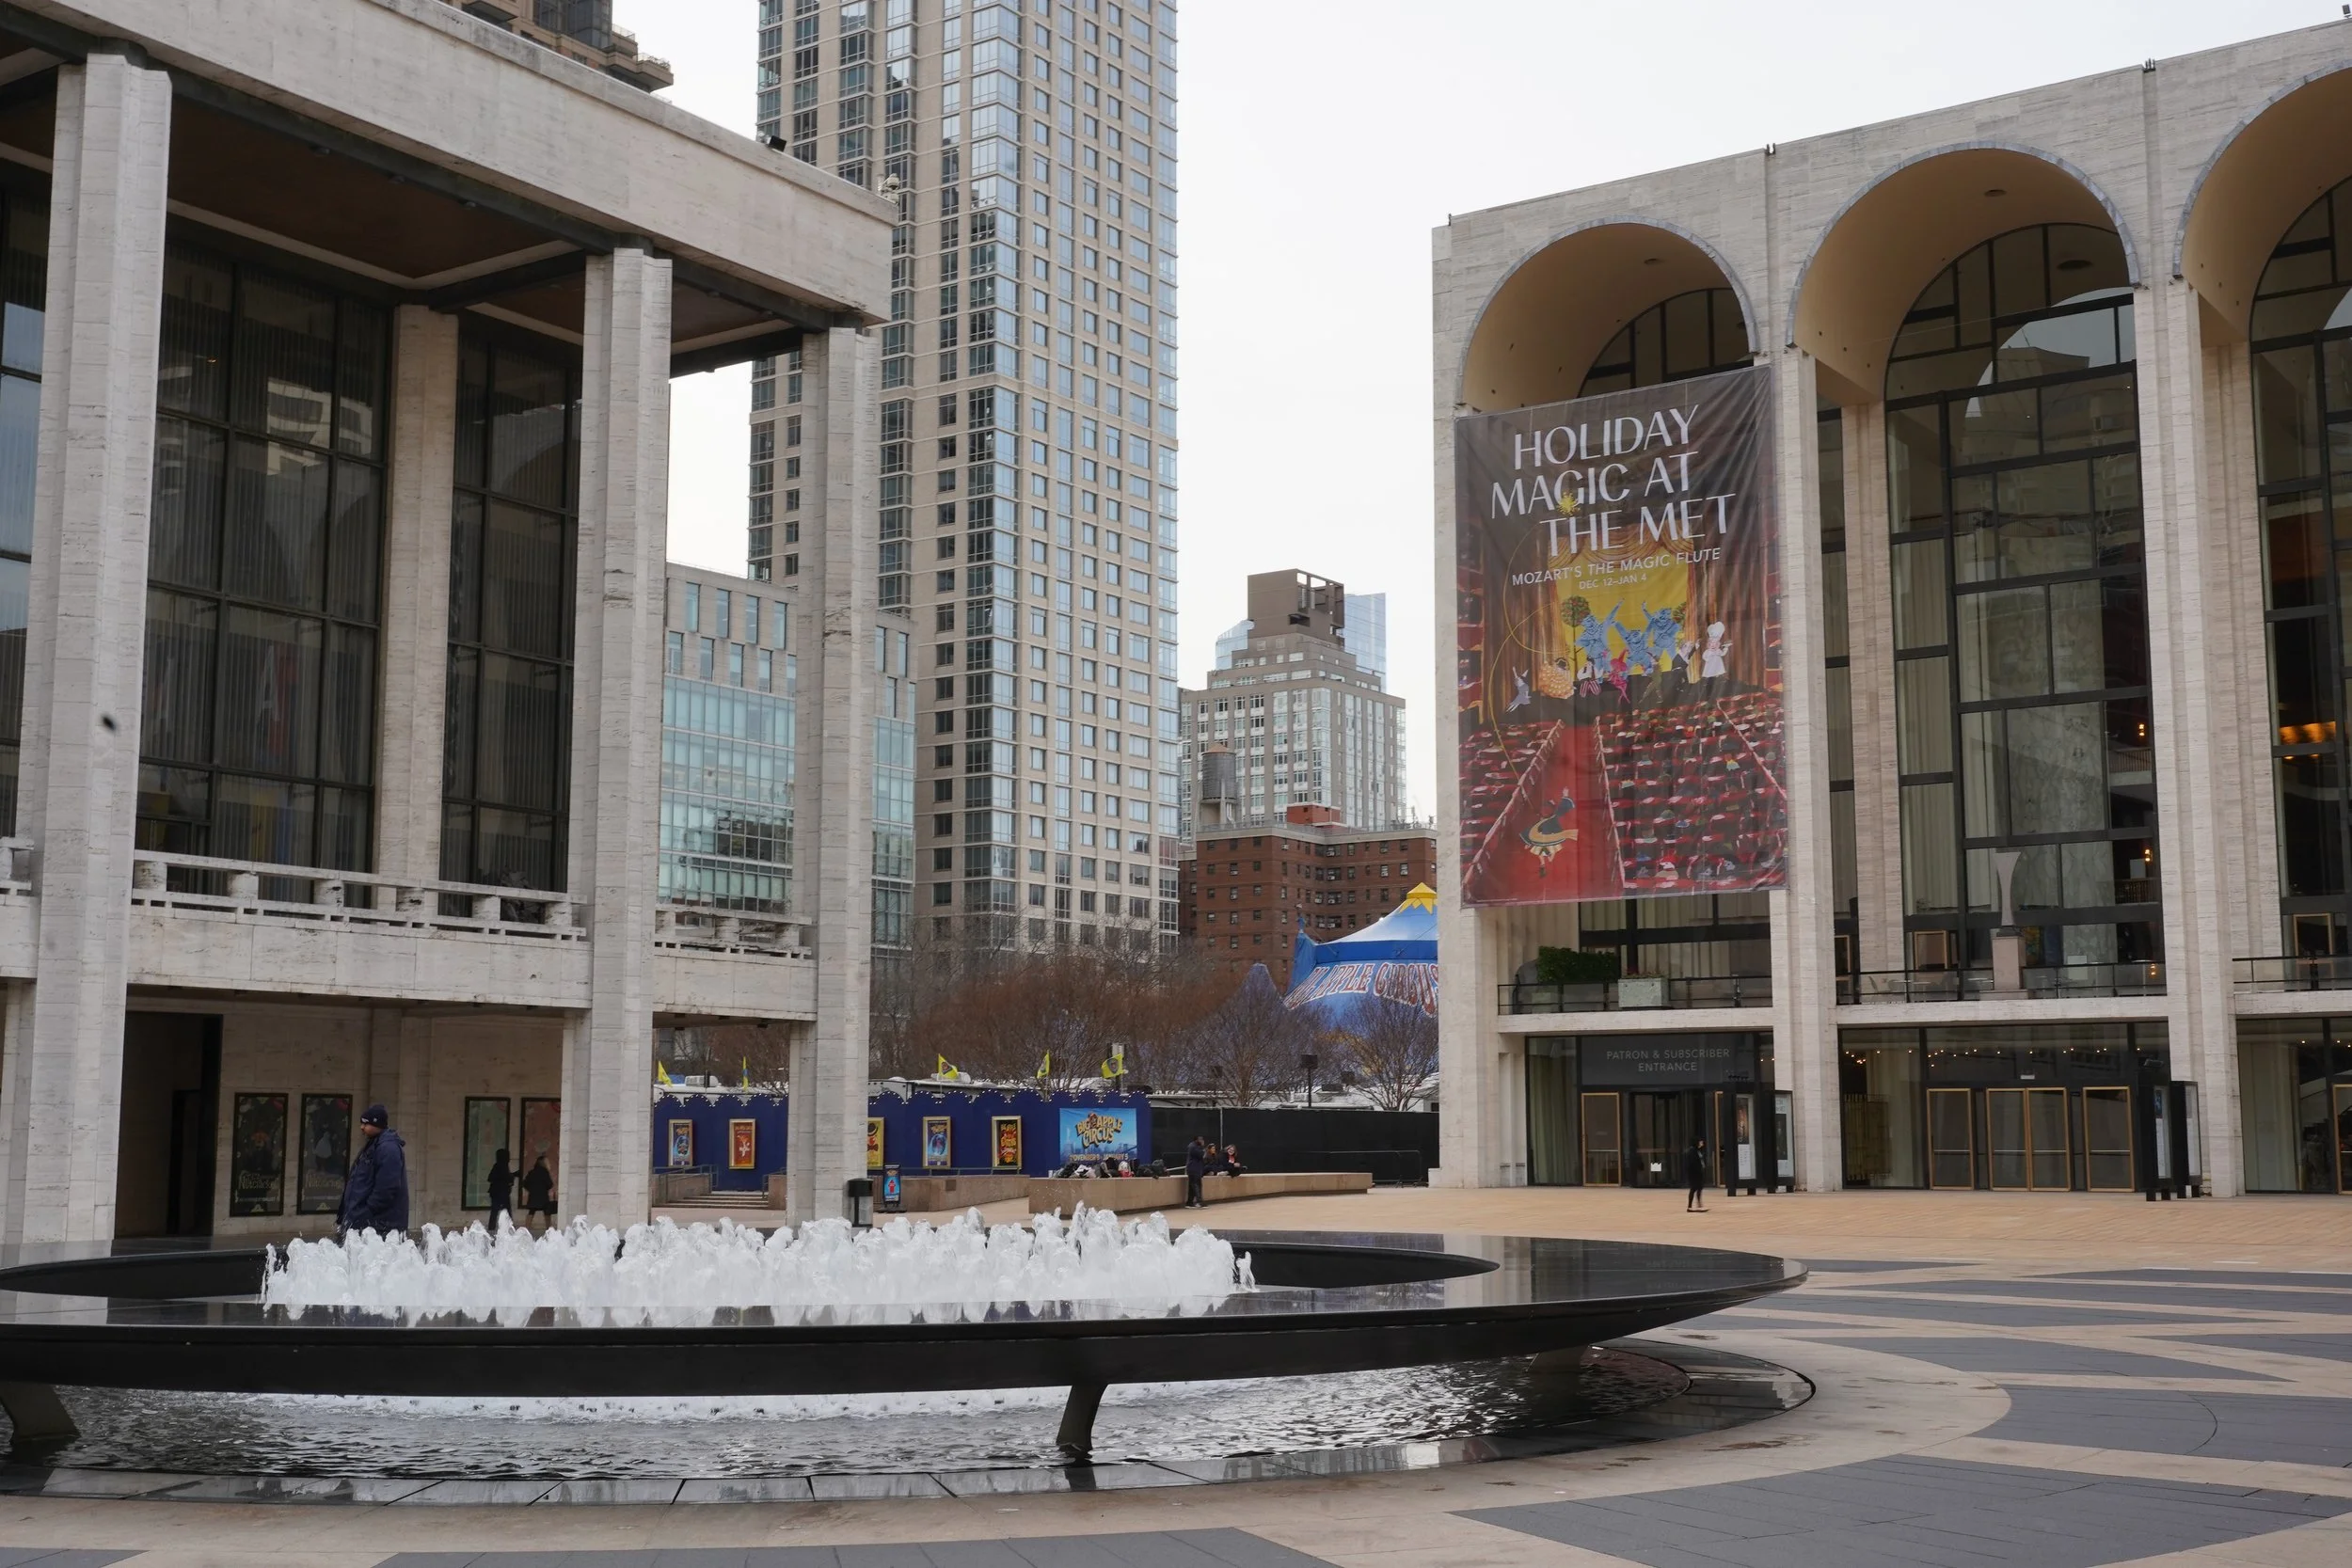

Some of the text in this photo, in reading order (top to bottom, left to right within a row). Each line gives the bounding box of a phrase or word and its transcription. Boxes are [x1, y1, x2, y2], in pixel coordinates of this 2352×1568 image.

[1514, 404, 1699, 470] HOLIDAY
[1491, 451, 1699, 519] MAGIC AT
[1539, 493, 1736, 557] THE MET
[1512, 547, 1721, 586] MOZART'S THE MAGIC FLUTE
[1579, 578, 1599, 590] DEC
[1640, 573, 1647, 581] 4
[1606, 1048, 1730, 1060] PATRON & SUBSCRIBER
[1638, 1062, 1698, 1072] ENTRANCE
[1076, 1116, 1122, 1135] BIG APPLE
[1082, 1127, 1115, 1148] CIRCUS
